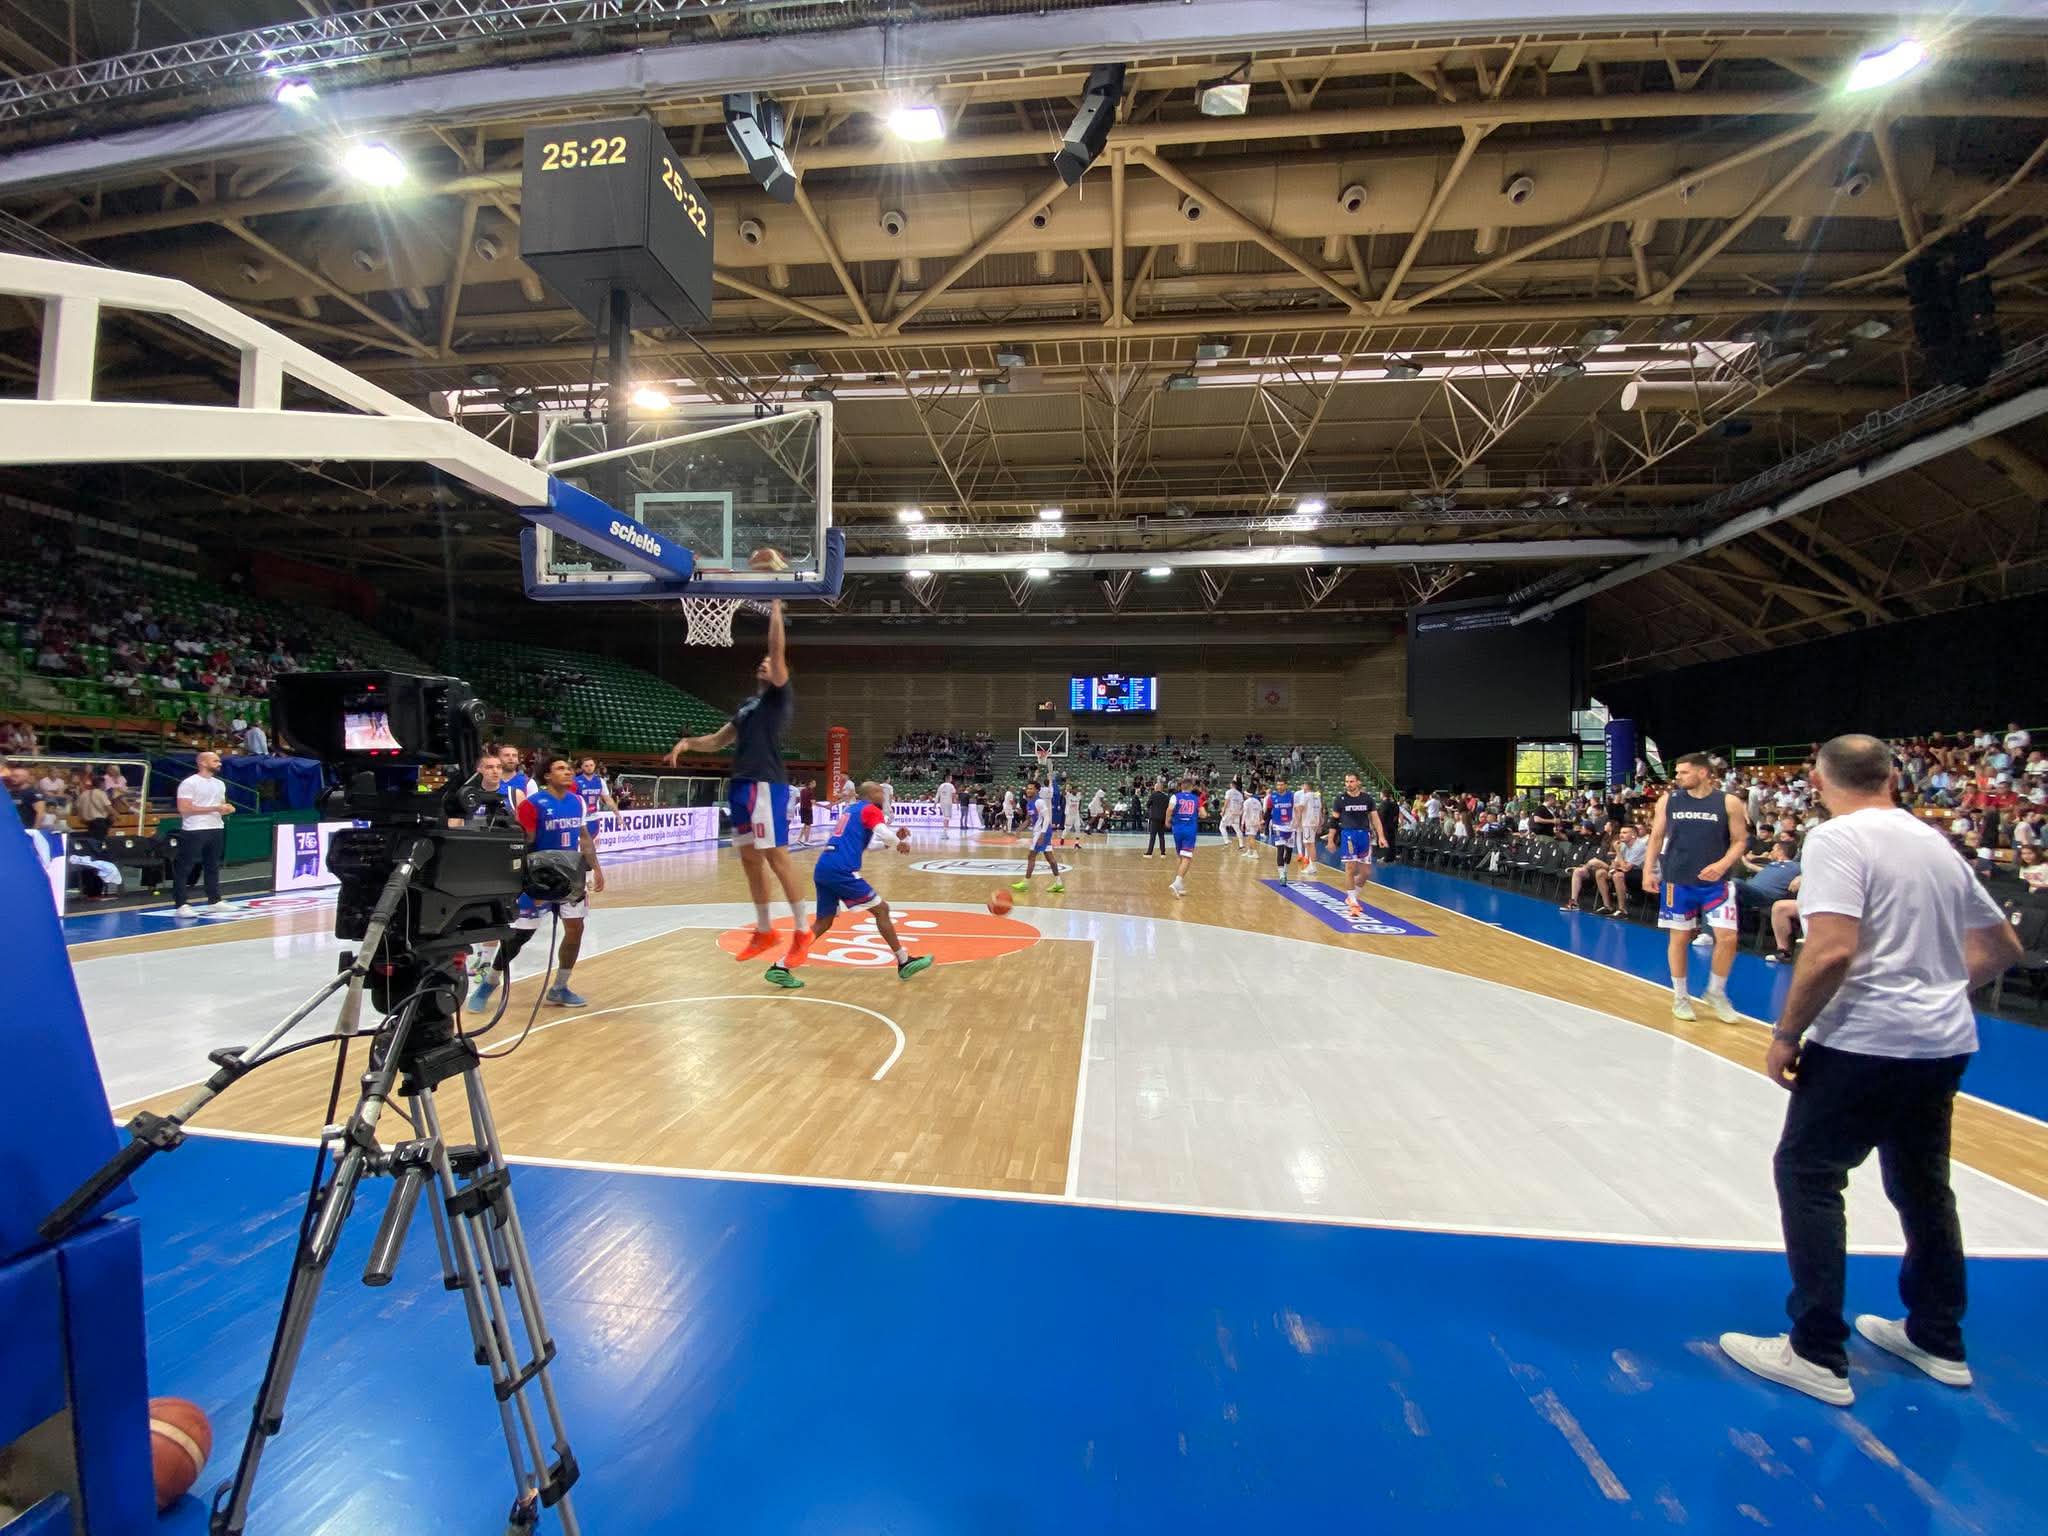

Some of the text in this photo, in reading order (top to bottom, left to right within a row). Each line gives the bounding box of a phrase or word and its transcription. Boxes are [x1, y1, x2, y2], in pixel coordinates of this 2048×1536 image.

[541, 136, 627, 171] 25:22
[662, 157, 706, 238] 25:22
[1672, 811, 1719, 821] IGOKEA
